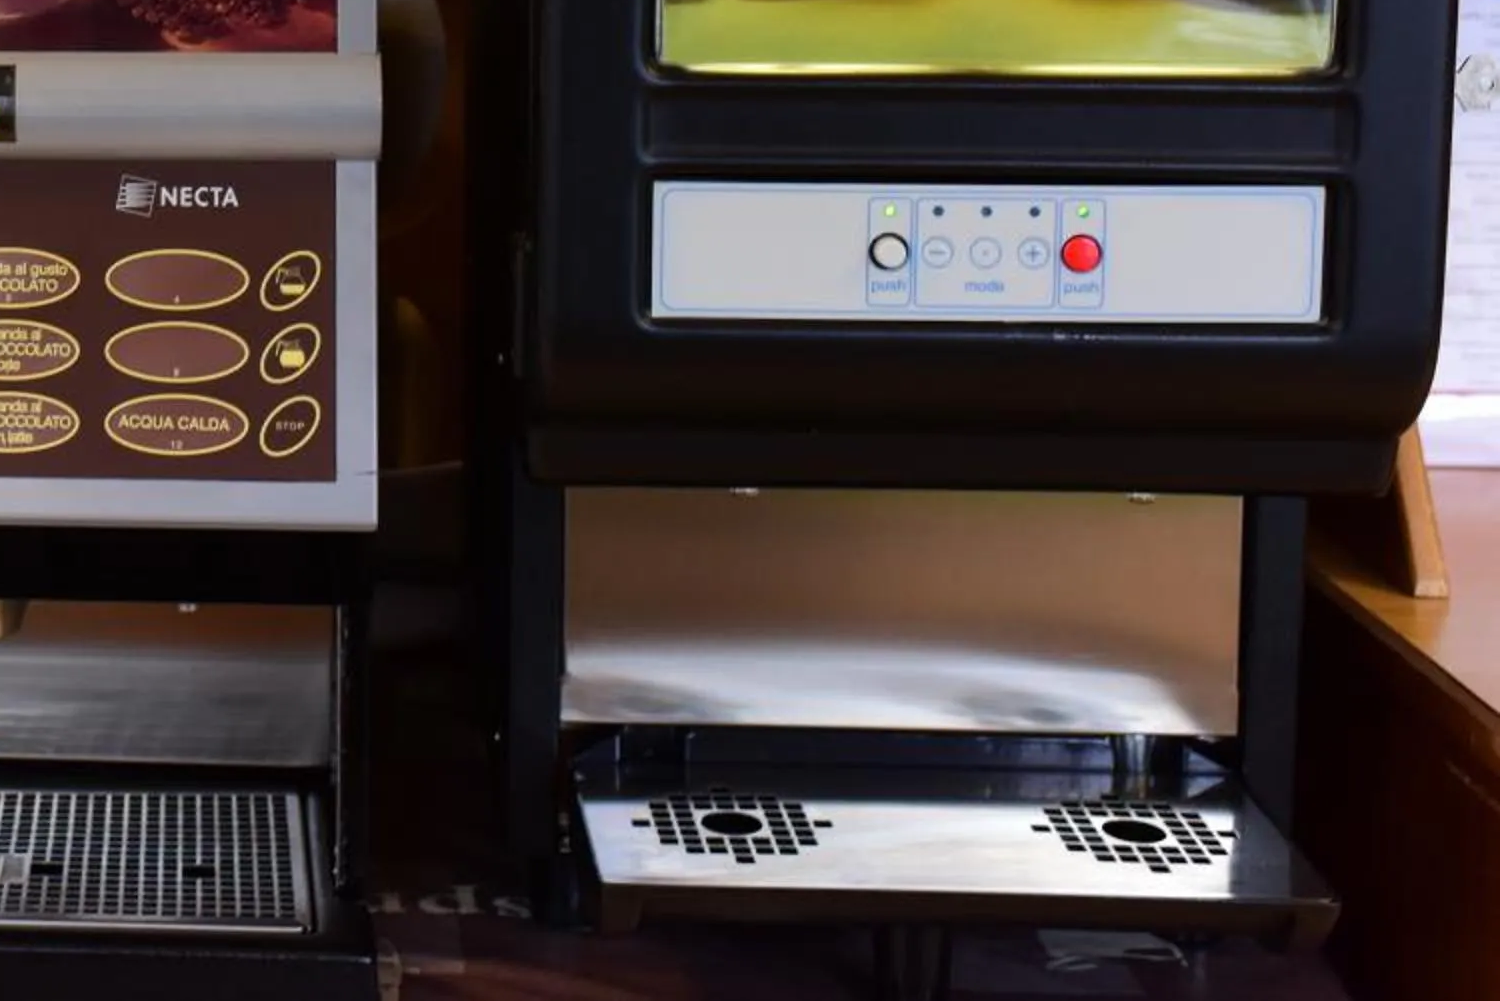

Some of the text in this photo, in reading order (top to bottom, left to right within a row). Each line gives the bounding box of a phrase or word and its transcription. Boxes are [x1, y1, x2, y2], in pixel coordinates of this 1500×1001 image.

[160, 186, 239, 208] NECTA
[871, 279, 906, 294] push
[964, 280, 1005, 293] mode
[1063, 280, 1100, 295] push
[118, 414, 231, 432] ACQUA CALDA
[275, 420, 305, 432] STOP
